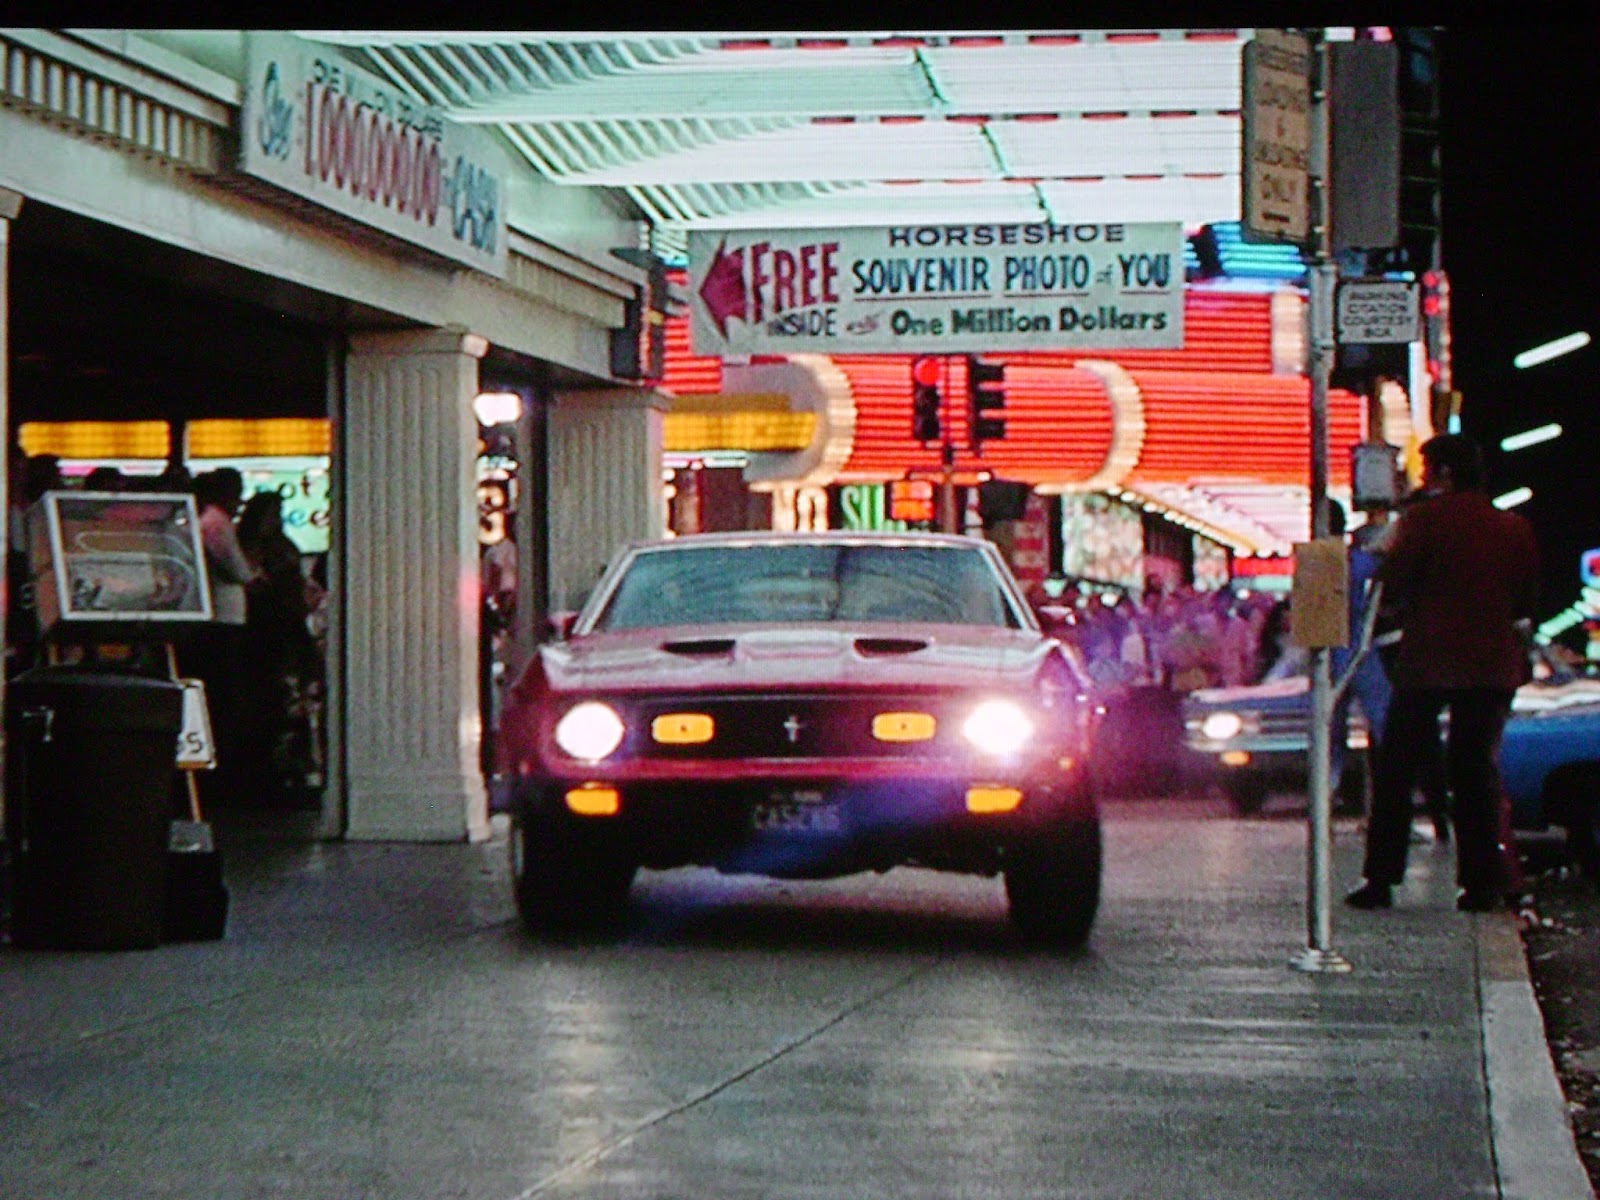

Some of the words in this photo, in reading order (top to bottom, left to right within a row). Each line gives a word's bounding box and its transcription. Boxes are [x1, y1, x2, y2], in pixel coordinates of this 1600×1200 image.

[889, 225, 1125, 247] HORSESHOE
[751, 242, 840, 324] FREE
[852, 256, 990, 294] SOUVENIR
[1004, 255, 1090, 290] PHOTO
[1117, 253, 1170, 287] YOU
[890, 309, 943, 335] One
[952, 307, 1051, 333] Million
[1059, 306, 1168, 331] Dollars
